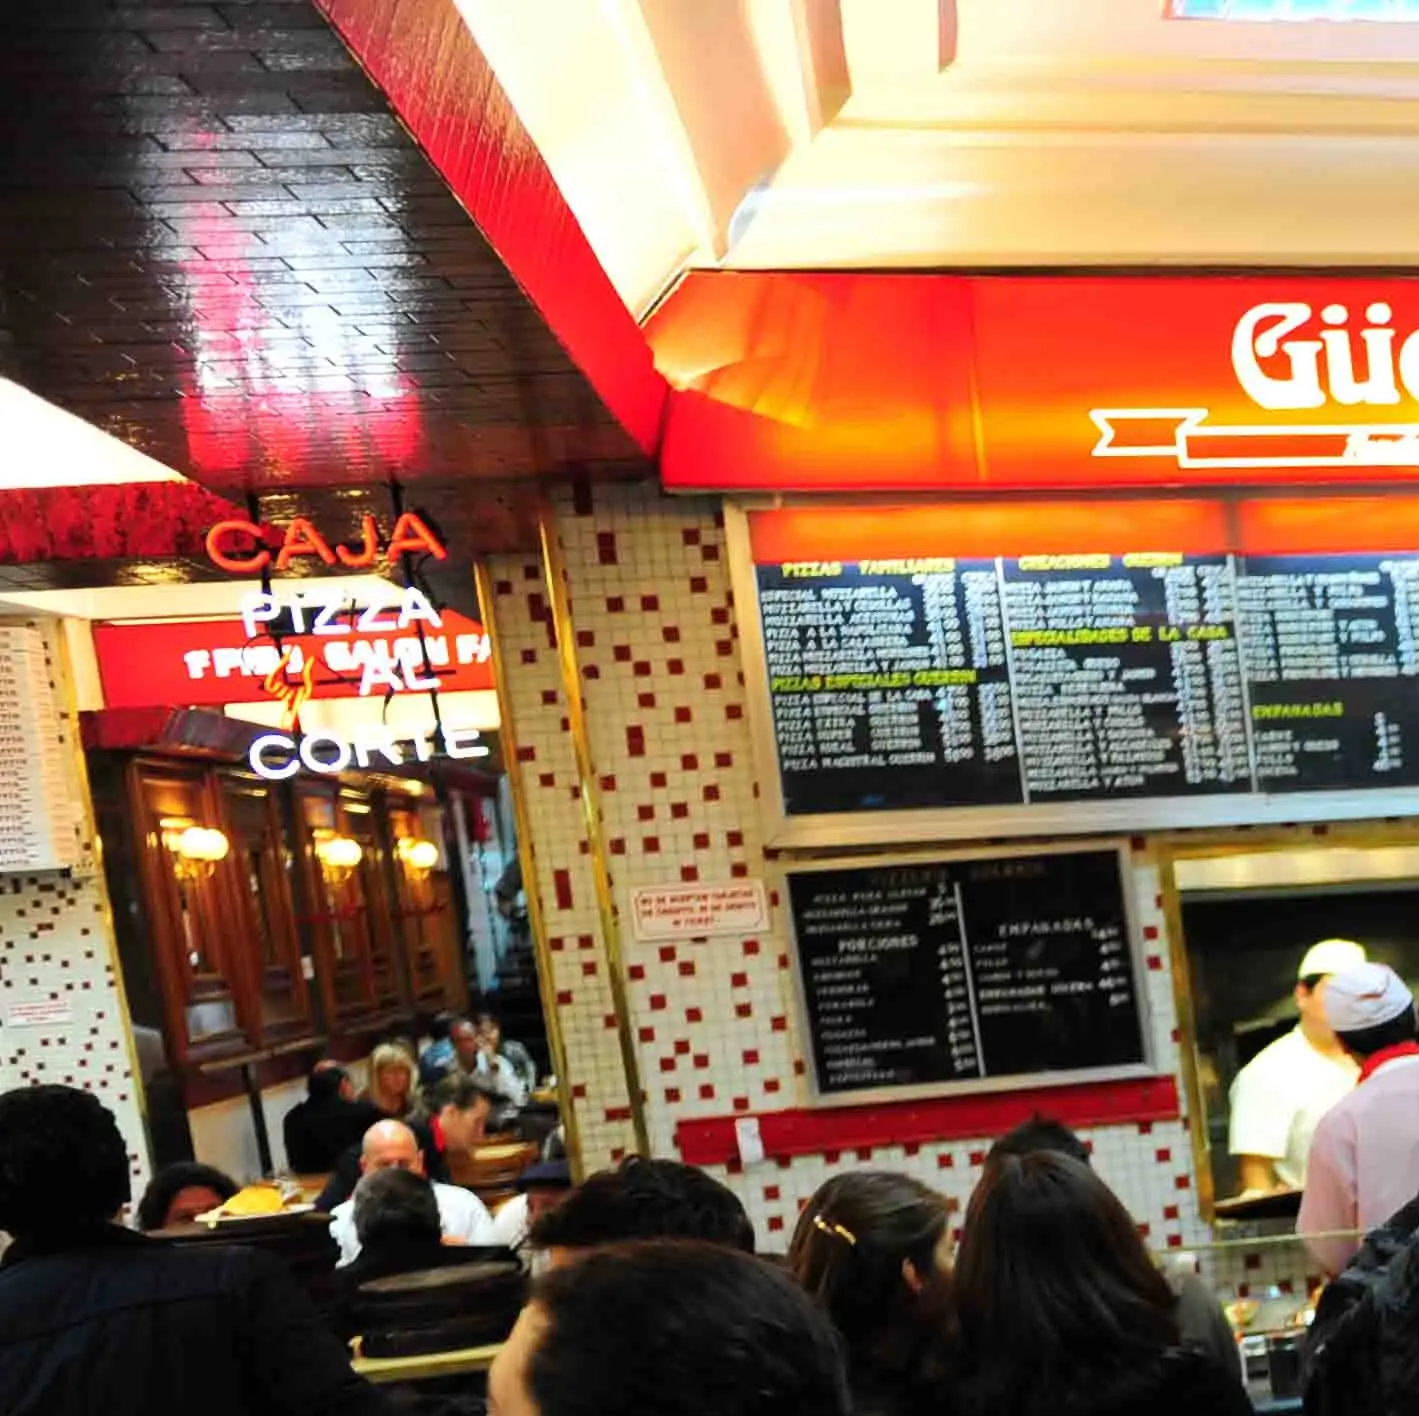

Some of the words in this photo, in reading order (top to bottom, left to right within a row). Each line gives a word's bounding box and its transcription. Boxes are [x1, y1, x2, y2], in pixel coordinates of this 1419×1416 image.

[205, 512, 449, 573] CAJA
[239, 586, 443, 638] PIZZA
[1158, 625, 1181, 642] LA
[359, 653, 442, 696] AL
[248, 726, 489, 781] CORTE
[837, 933, 919, 954] PORCIONES
[998, 916, 1095, 939] EMPANADAS
